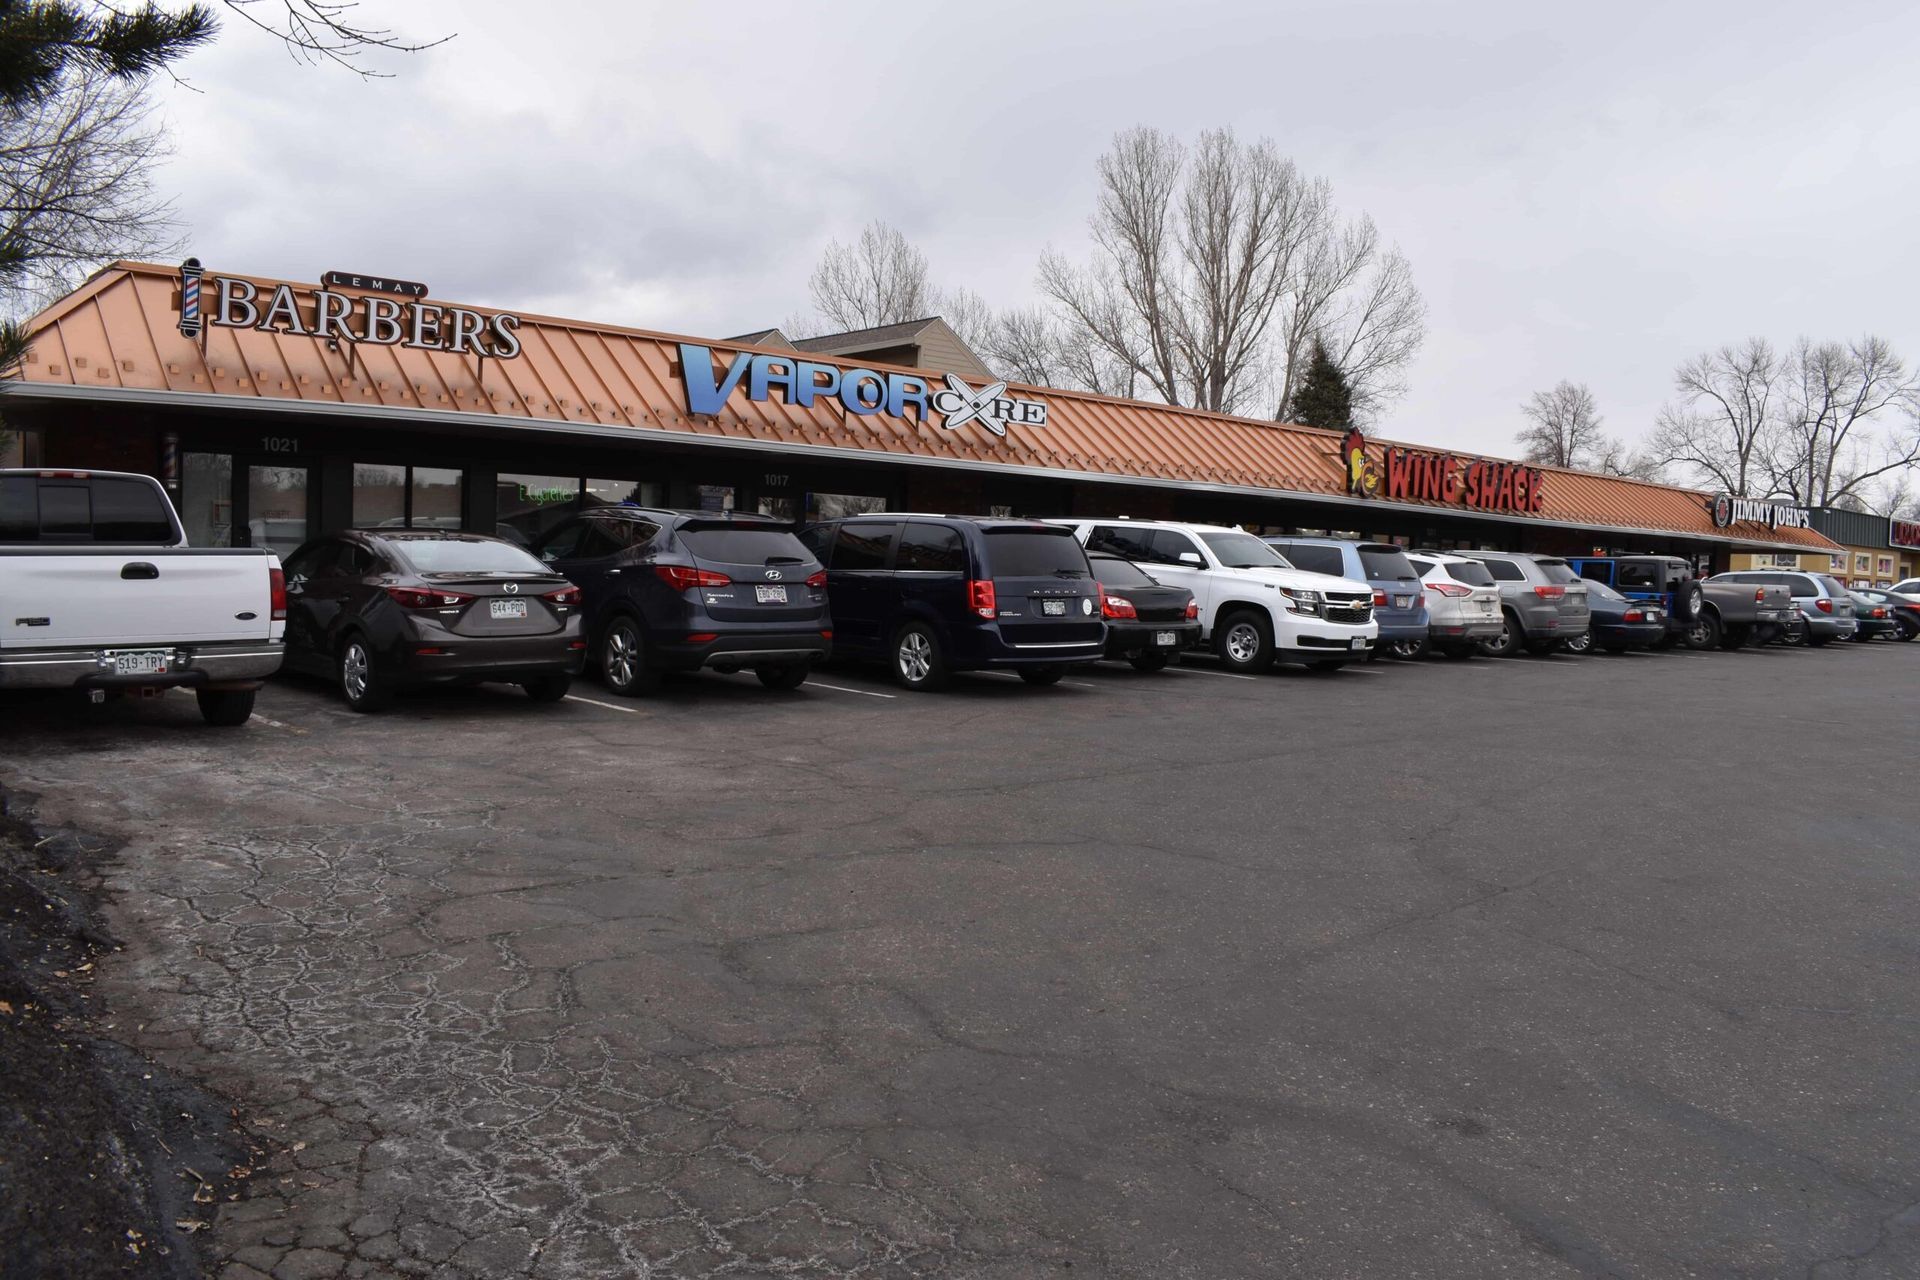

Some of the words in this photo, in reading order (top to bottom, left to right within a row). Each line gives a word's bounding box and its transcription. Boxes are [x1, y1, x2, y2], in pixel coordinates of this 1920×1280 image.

[332, 274, 421, 295] LEMAY
[211, 276, 521, 359] BARBERS
[678, 343, 929, 422] VAPOR
[261, 437, 299, 452] 1021
[764, 473, 789, 487] 1017
[1385, 446, 1458, 503] WING
[1465, 458, 1544, 513] SHACK
[1731, 499, 1772, 525] JIMMY
[1773, 505, 1810, 530] JOHN'S
